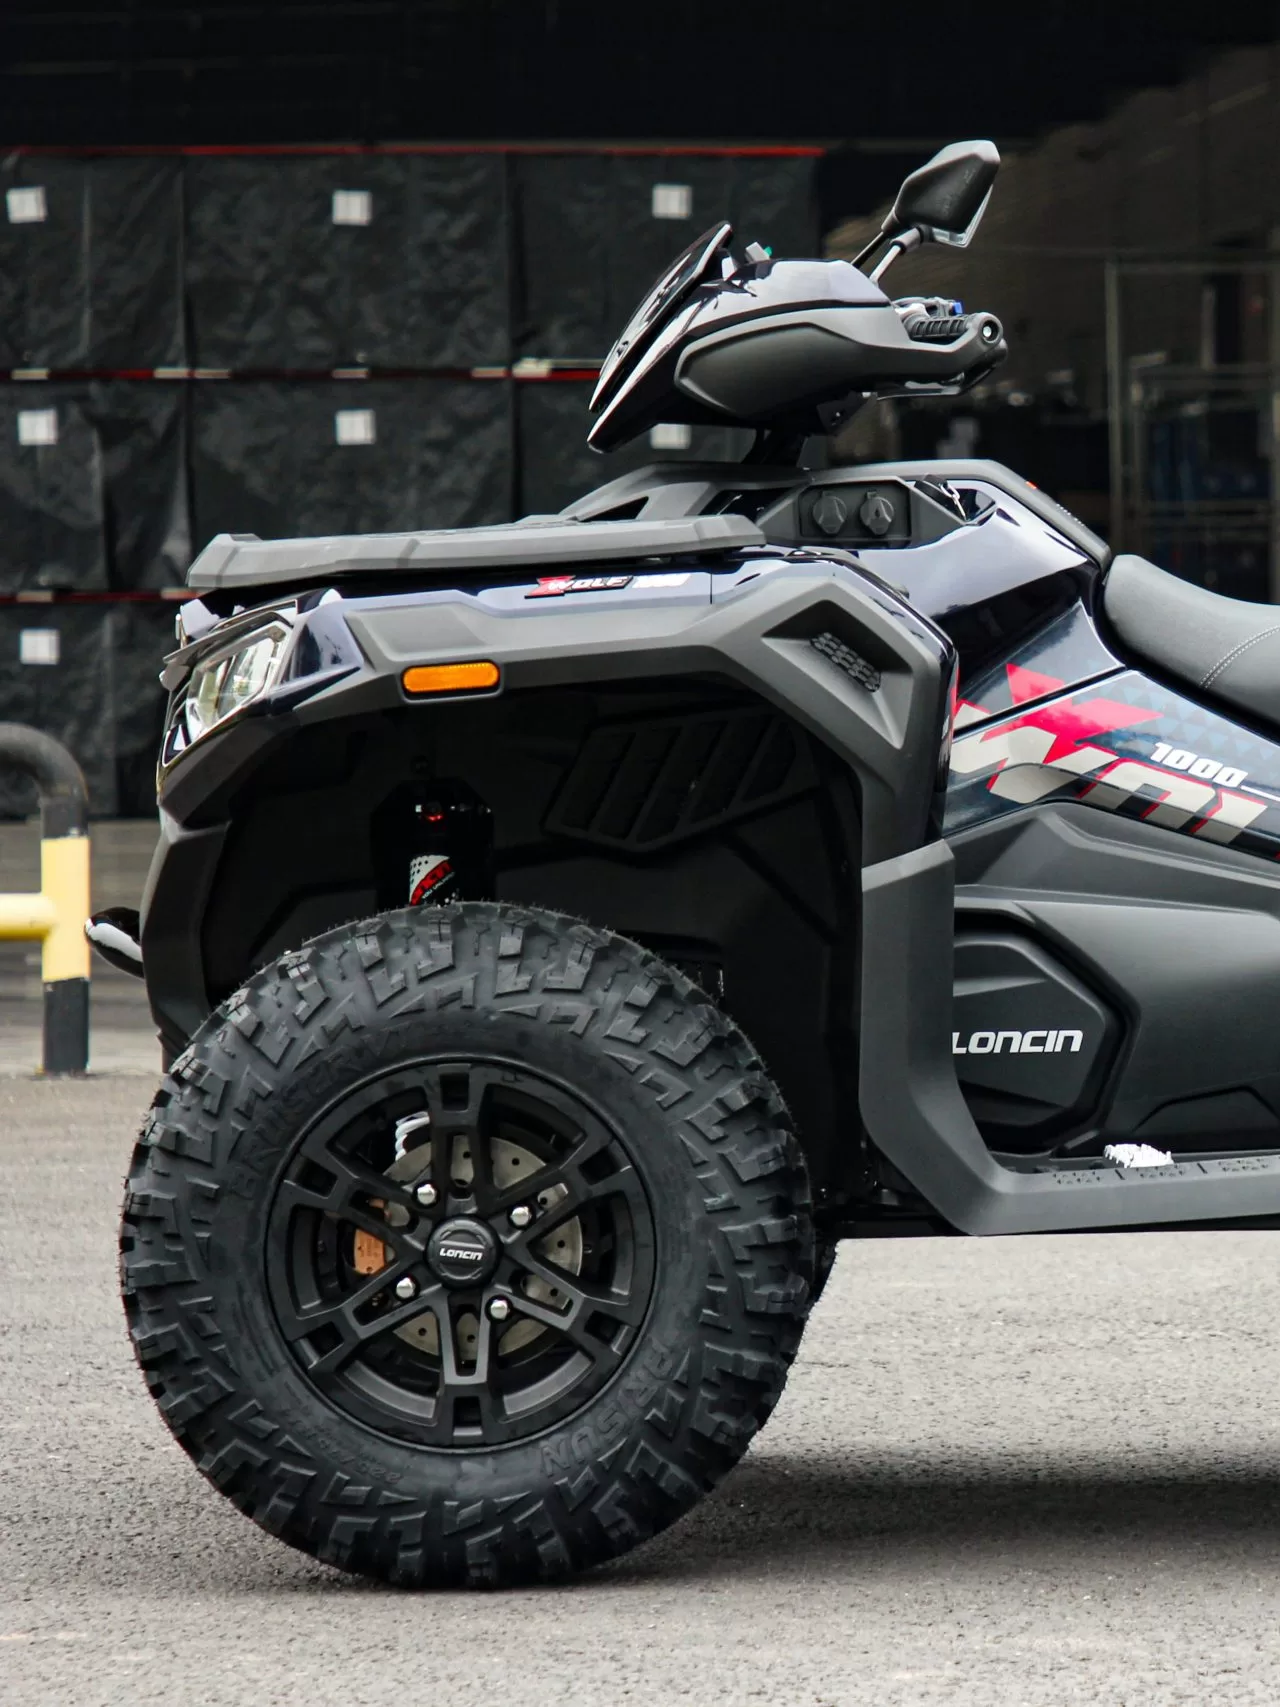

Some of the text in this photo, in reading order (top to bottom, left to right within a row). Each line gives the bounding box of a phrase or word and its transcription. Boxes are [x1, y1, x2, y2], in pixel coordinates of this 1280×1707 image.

[1150, 742, 1249, 788] 1000
[951, 1029, 1084, 1054] LONCIN
[440, 1248, 483, 1261] LONCIN
